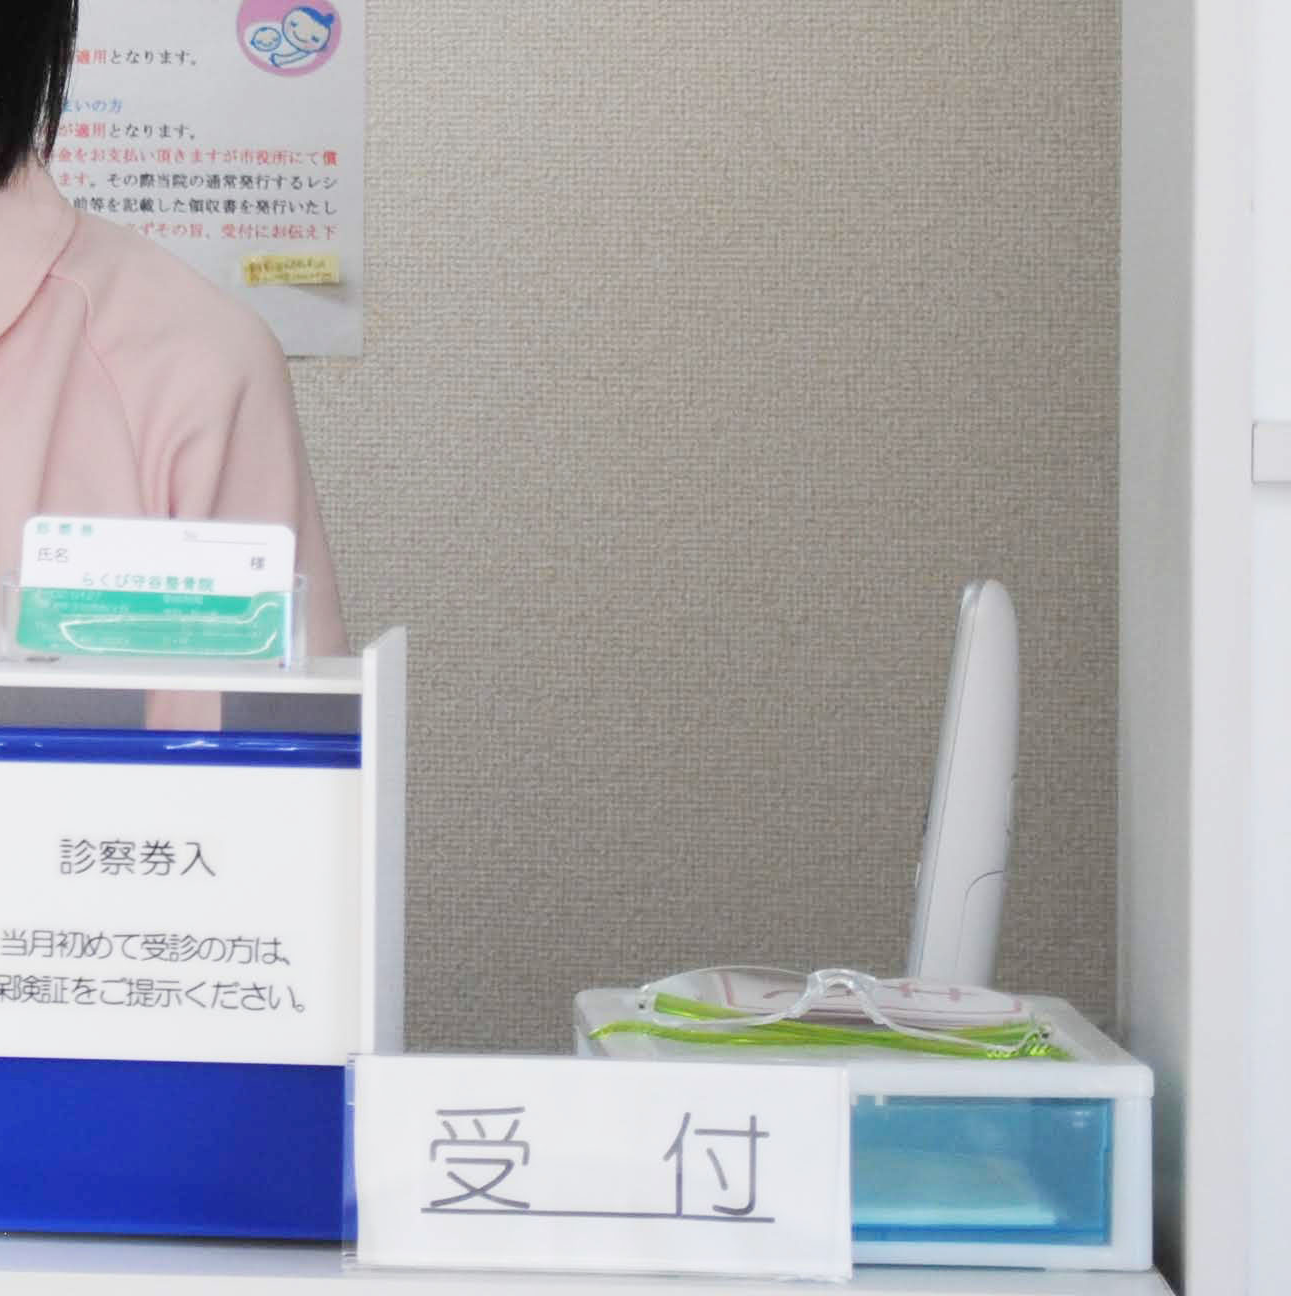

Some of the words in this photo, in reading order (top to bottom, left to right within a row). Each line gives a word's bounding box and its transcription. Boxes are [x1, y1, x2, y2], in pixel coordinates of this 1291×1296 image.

[50, 149, 338, 167] 金をお支払い頂きますが市役所にて償
[128, 223, 338, 241] ずその旨、受付にお伝え下
[59, 837, 217, 877] 診察券入
[0, 928, 291, 967] 当月初めて受診の方は、
